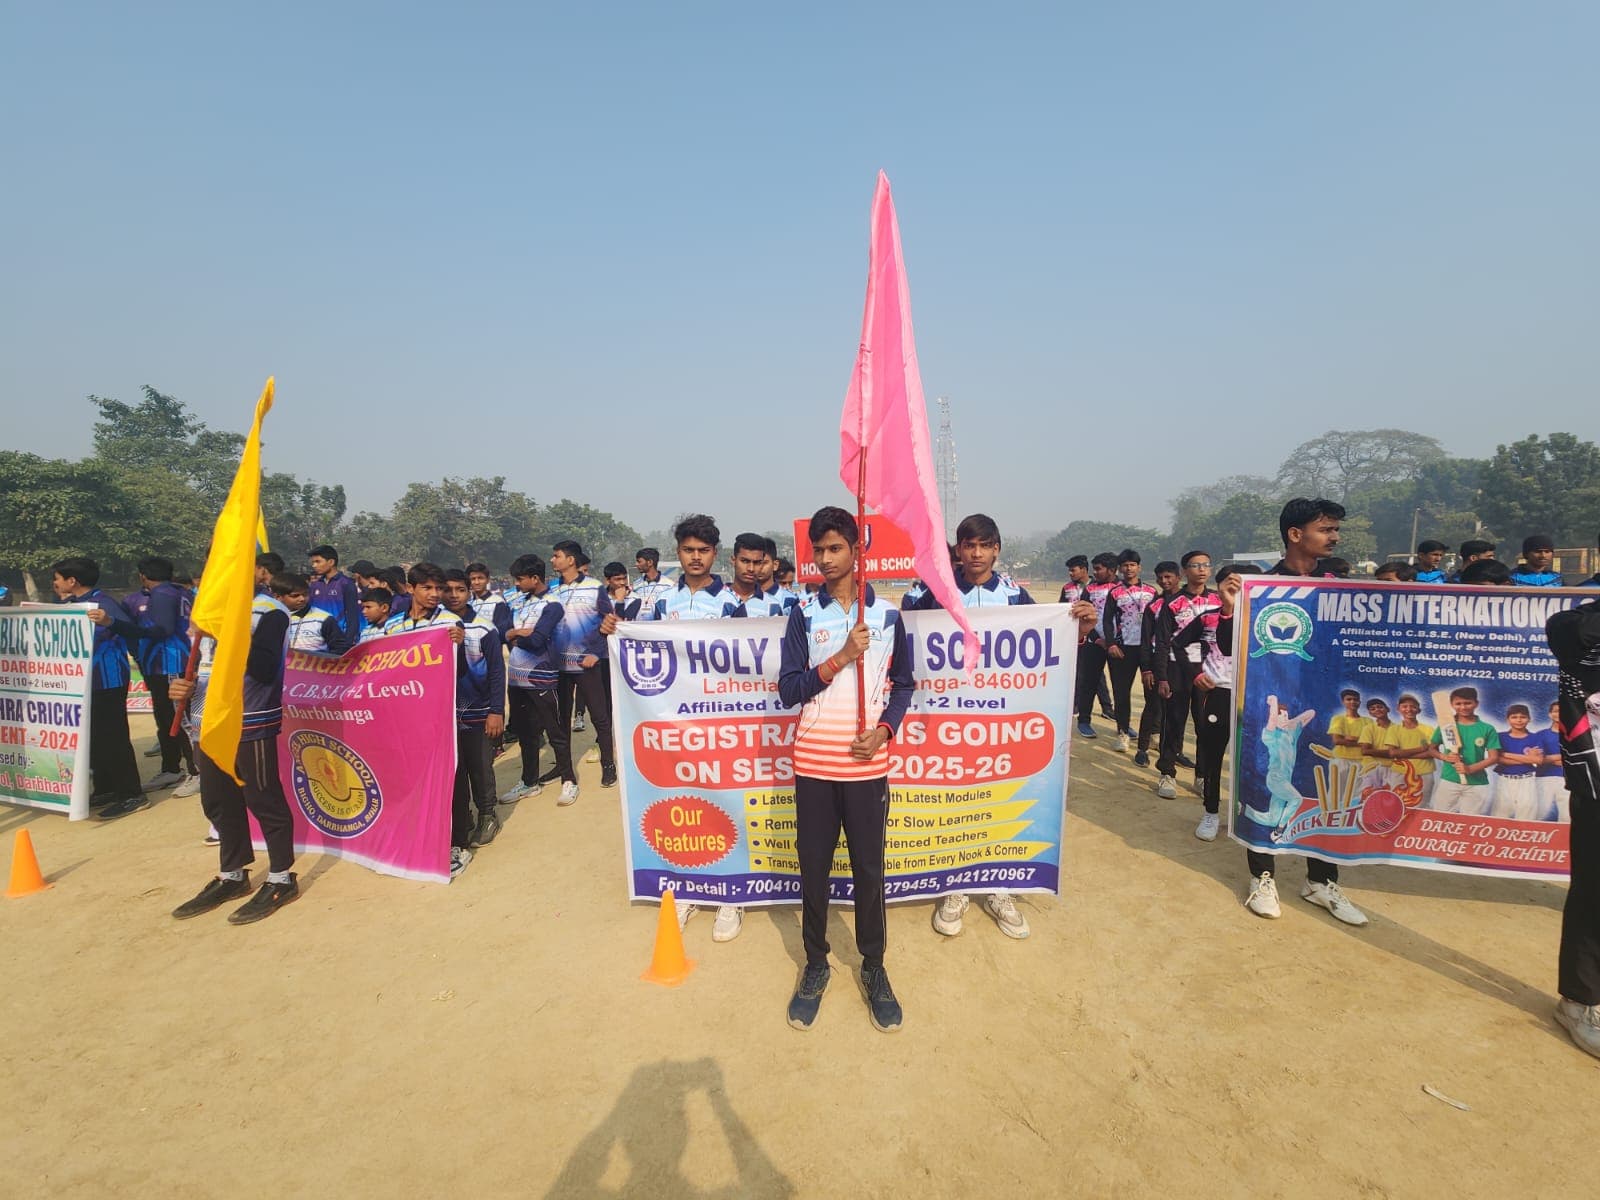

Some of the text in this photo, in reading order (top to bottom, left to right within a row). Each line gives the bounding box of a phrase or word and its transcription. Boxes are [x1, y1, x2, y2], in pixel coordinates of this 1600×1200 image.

[1317, 592, 1383, 623] MASS
[34, 617, 89, 659] SCHOOL
[1340, 627, 1388, 636] Affiliated
[1406, 630, 1451, 638] C.B.S.E.
[1455, 631, 1485, 640] (New
[1489, 632, 1526, 642] Delhi),
[686, 637, 769, 676] HOLY
[926, 628, 1060, 672] SCHOOL
[1342, 639, 1421, 648] Co-educational
[1425, 642, 1462, 650] Senior
[1466, 643, 1529, 655] Secondary
[1343, 650, 1559, 666] EKMI ROAD, BALLOPUR, LAHERIASAR
[2, 660, 84, 677] DARBHANGA
[287, 643, 443, 675] HIGH SCHOOL
[13, 677, 40, 688] (10+2
[41, 679, 67, 691] level)
[974, 671, 1048, 690] 846001
[1358, 665, 1397, 673] Contact
[1428, 668, 1495, 680] 9386474222,
[1498, 671, 1559, 682] 906551778
[368, 680, 424, 698] Level)
[287, 704, 374, 724] Darbhanga
[677, 700, 767, 714] Affiliated
[926, 697, 950, 709] +2
[957, 696, 1006, 709] level
[40, 729, 78, 750] 2024
[896, 721, 927, 745] IS
[938, 717, 1046, 747] GOING
[297, 733, 326, 747] HIGH
[328, 741, 374, 788] SCHOOL
[675, 753, 1012, 784] ON SES 2025-26
[312, 781, 336, 812] SUCCESS
[906, 792, 942, 804] Latest
[945, 789, 992, 804] Modules
[316, 815, 366, 833] DARBHANGA,
[363, 798, 379, 823] BIHAR
[670, 805, 702, 827] Our
[903, 815, 935, 828] Slow
[939, 811, 992, 827] Learners
[654, 829, 726, 852] Features
[764, 838, 790, 849] Well
[936, 831, 988, 846] Teachers
[1420, 818, 1560, 844] DARE TO DREAM
[904, 858, 926, 869] from
[929, 854, 955, 868] Every
[958, 848, 982, 861] Nook
[985, 846, 992, 857] &
[994, 844, 1028, 857] Corner
[1393, 835, 1569, 864] COURAGE TO ACHIEVE
[658, 876, 681, 891] For
[686, 880, 727, 896] Detail
[945, 867, 1036, 887] 9421270967
